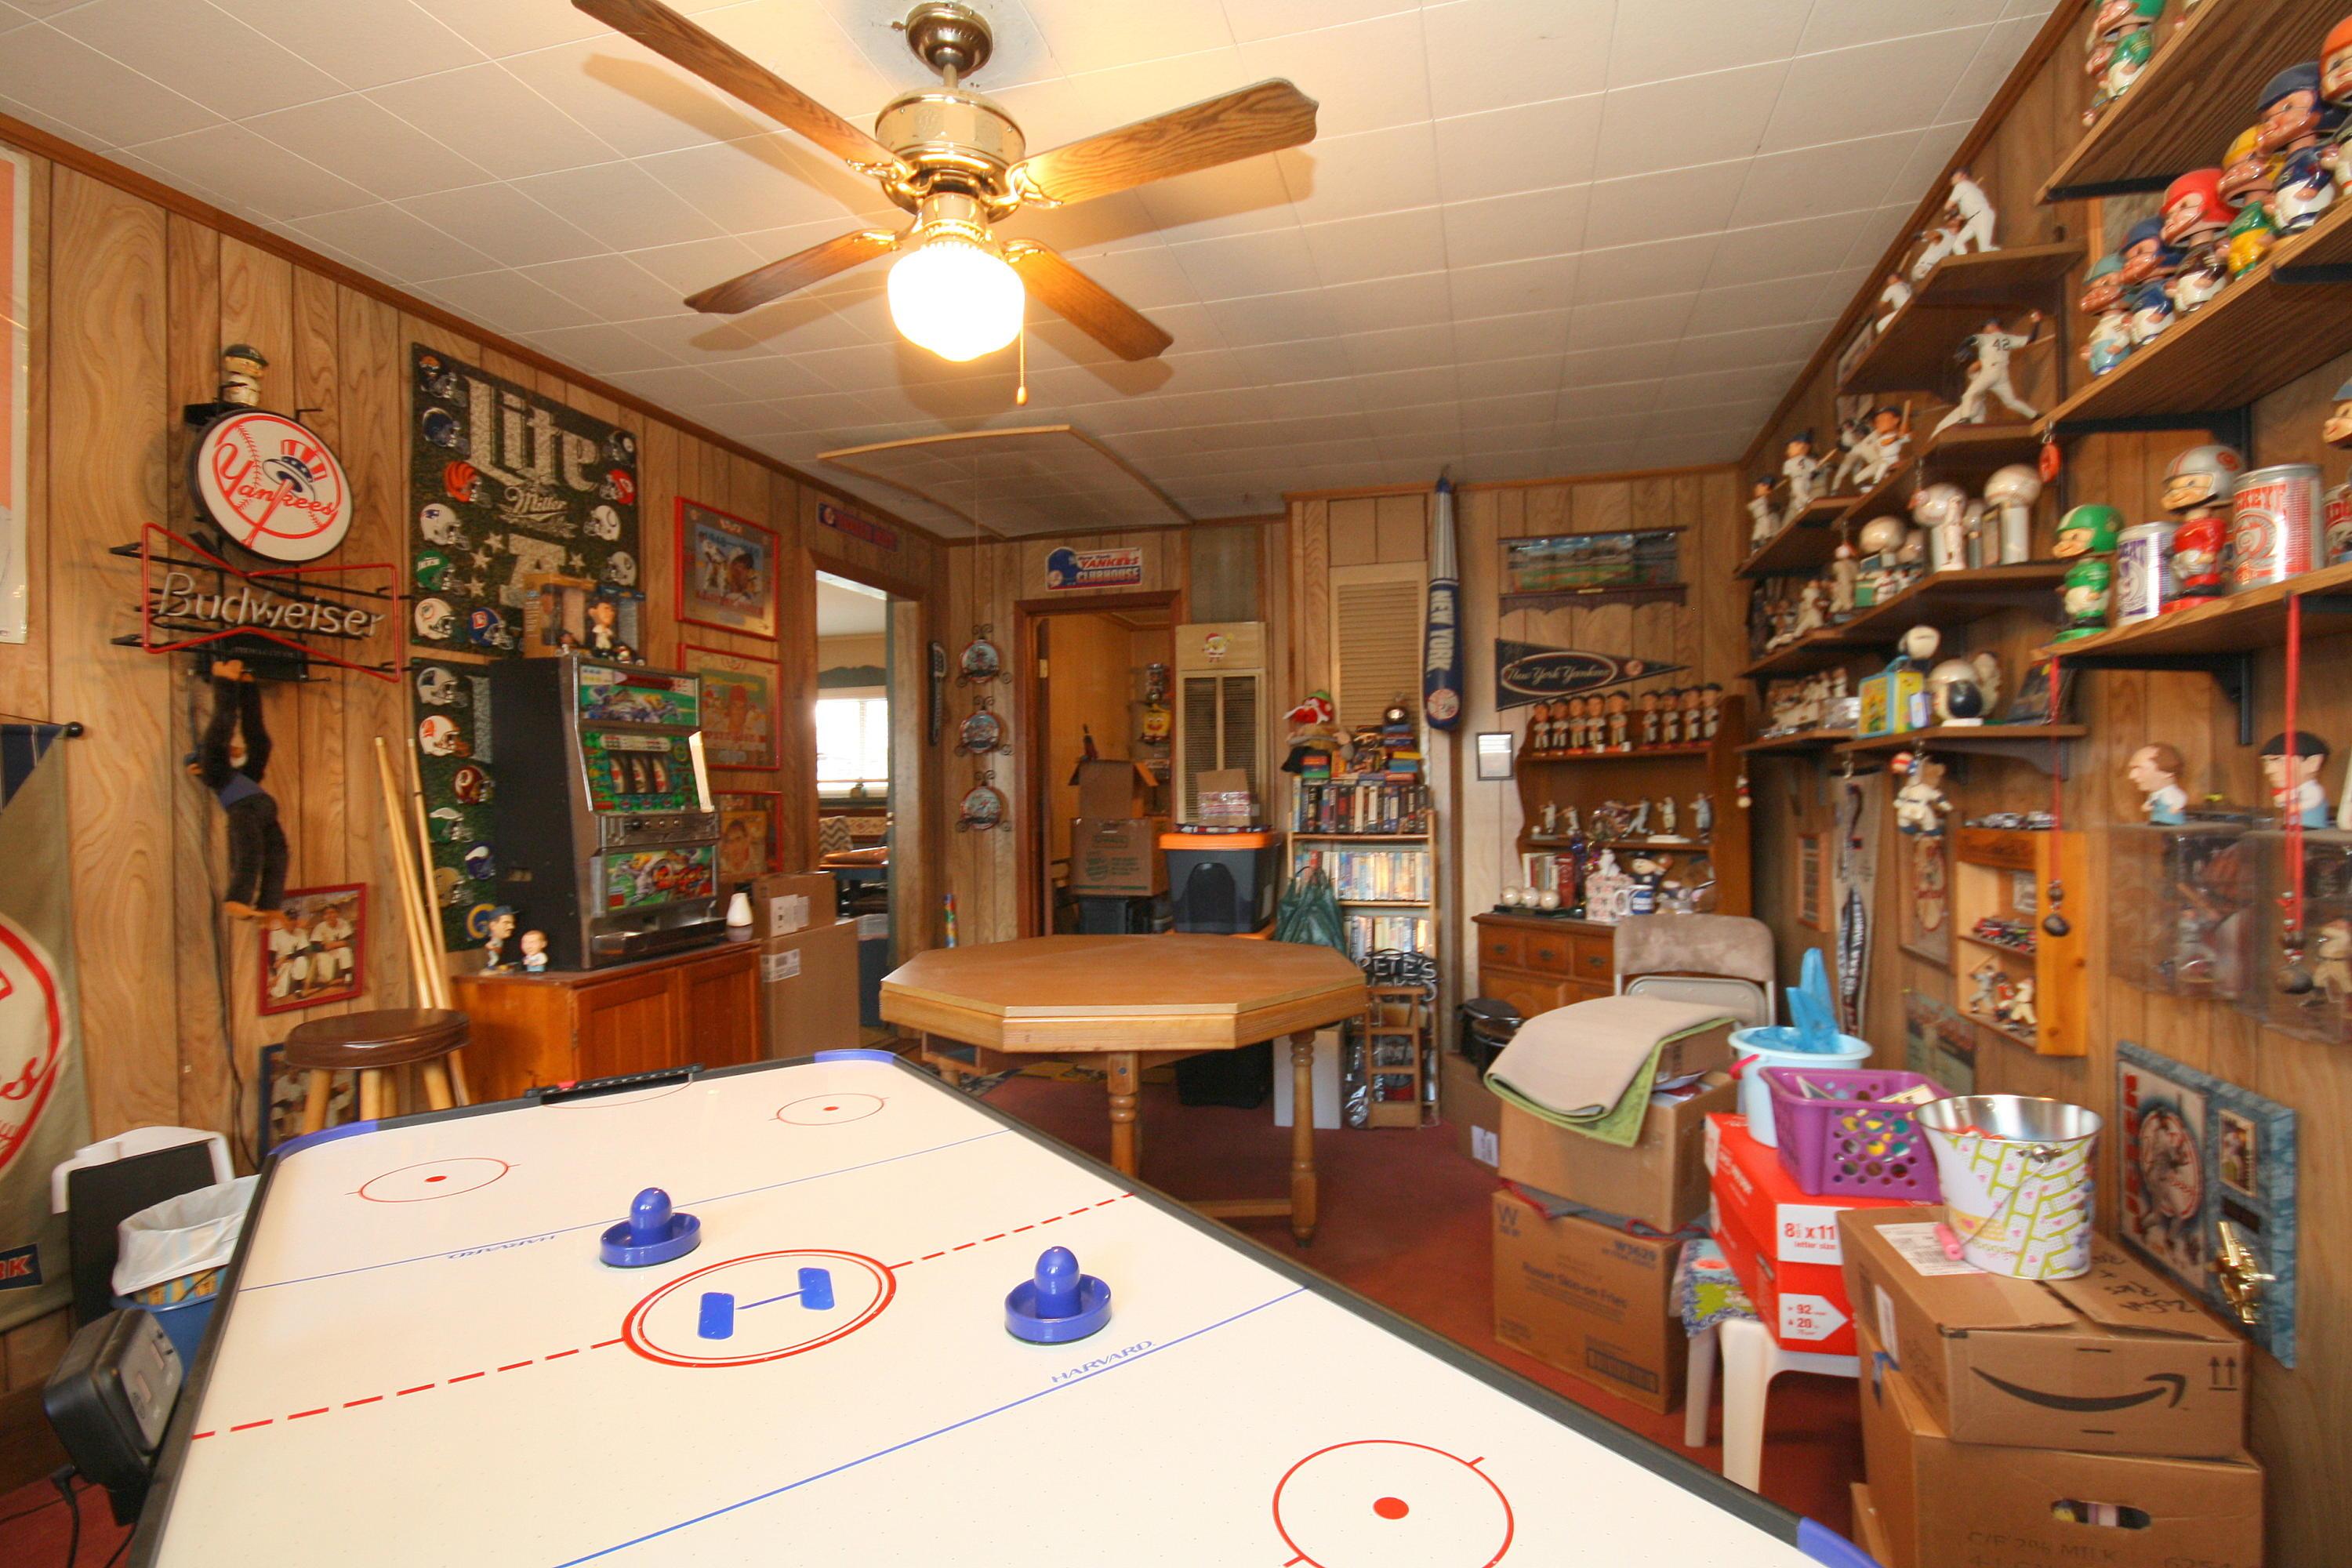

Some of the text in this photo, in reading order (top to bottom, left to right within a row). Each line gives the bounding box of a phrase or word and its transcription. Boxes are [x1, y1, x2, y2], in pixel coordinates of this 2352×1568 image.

[1992, 338, 2010, 351] 42
[464, 374, 601, 492] Lite
[211, 441, 337, 517] Yankees
[503, 485, 568, 514] Miller
[1076, 567, 1140, 583] CLUBHOUSE
[1081, 556, 1140, 569] YANKEES
[158, 572, 387, 637] Budweiser
[1426, 589, 1456, 672] NEW YORK
[1507, 665, 1610, 686] New York Yankees
[1356, 955, 1437, 979] PETE'S
[1796, 1304, 1813, 1315] 92
[1051, 1340, 1154, 1383] HARVARD
